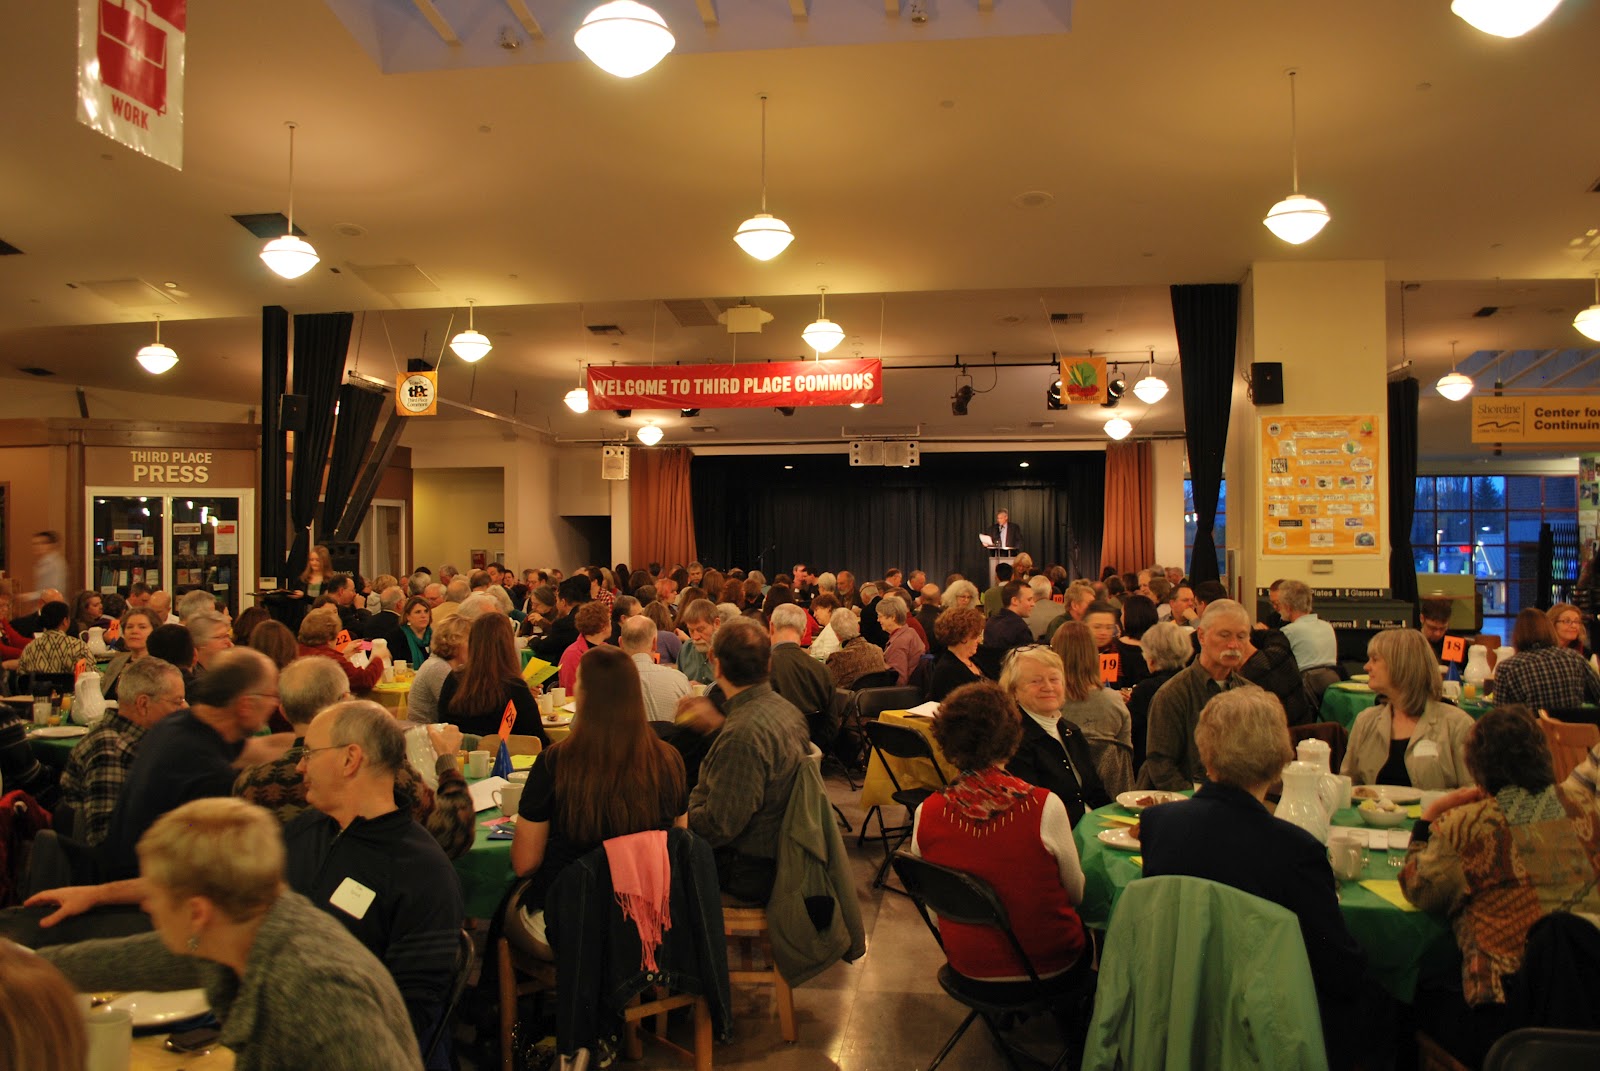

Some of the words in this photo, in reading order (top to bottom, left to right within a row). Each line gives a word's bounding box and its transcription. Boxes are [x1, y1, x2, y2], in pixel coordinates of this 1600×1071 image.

[112, 94, 148, 130] WORK
[593, 379, 667, 396] WELCOME
[671, 379, 691, 395] TO
[694, 378, 740, 395] THIRD
[743, 376, 791, 394] PLACE
[794, 373, 874, 392] COMMONS
[1478, 404, 1520, 414] Shoreline
[1534, 407, 1580, 417] Center
[130, 451, 169, 463] THIRD
[172, 452, 213, 464] PLACE
[133, 464, 209, 483] PRESS
[1310, 589, 1333, 597] Plates
[1350, 589, 1378, 597] Glasses
[335, 634, 348, 646] 22
[1446, 640, 1461, 651] 18
[1102, 659, 1117, 670] 19
